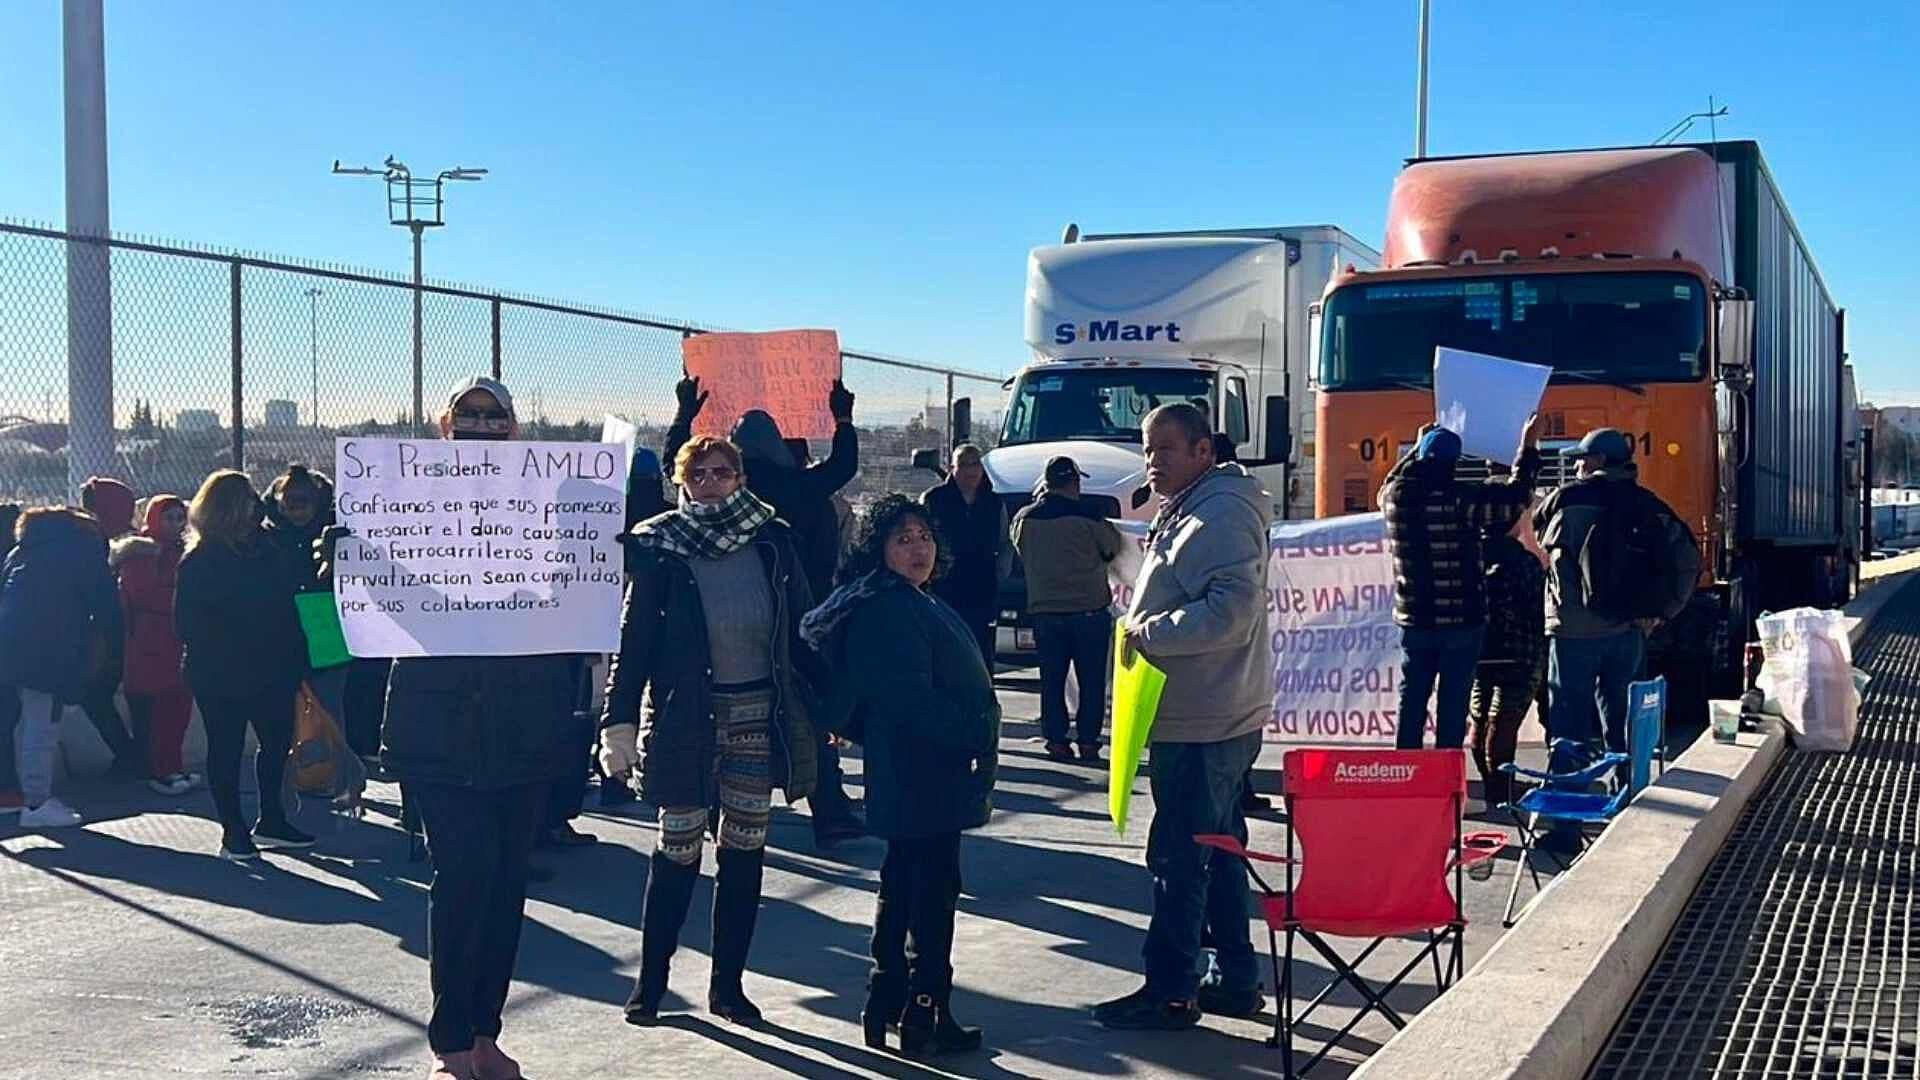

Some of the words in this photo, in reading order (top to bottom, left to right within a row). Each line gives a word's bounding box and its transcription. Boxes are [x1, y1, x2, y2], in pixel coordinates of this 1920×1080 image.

[344, 442, 379, 479] Sr.
[399, 443, 501, 478] Presidente
[521, 447, 615, 480] AMLO
[1360, 438, 1389, 461] 01
[338, 491, 435, 516] Confiamos
[443, 499, 463, 513] en
[469, 497, 499, 516] que
[507, 498, 537, 514] sus
[544, 500, 622, 524] promesas
[367, 524, 433, 539] resarcir
[442, 525, 463, 537] el
[522, 522, 599, 541] causado
[337, 550, 349, 561] a
[359, 544, 380, 561] los
[543, 552, 576, 564] con
[590, 547, 606, 563] la
[341, 600, 367, 618] por
[377, 599, 404, 613] sus
[420, 594, 560, 612] colaboradores
[1335, 761, 1417, 781] Academy
